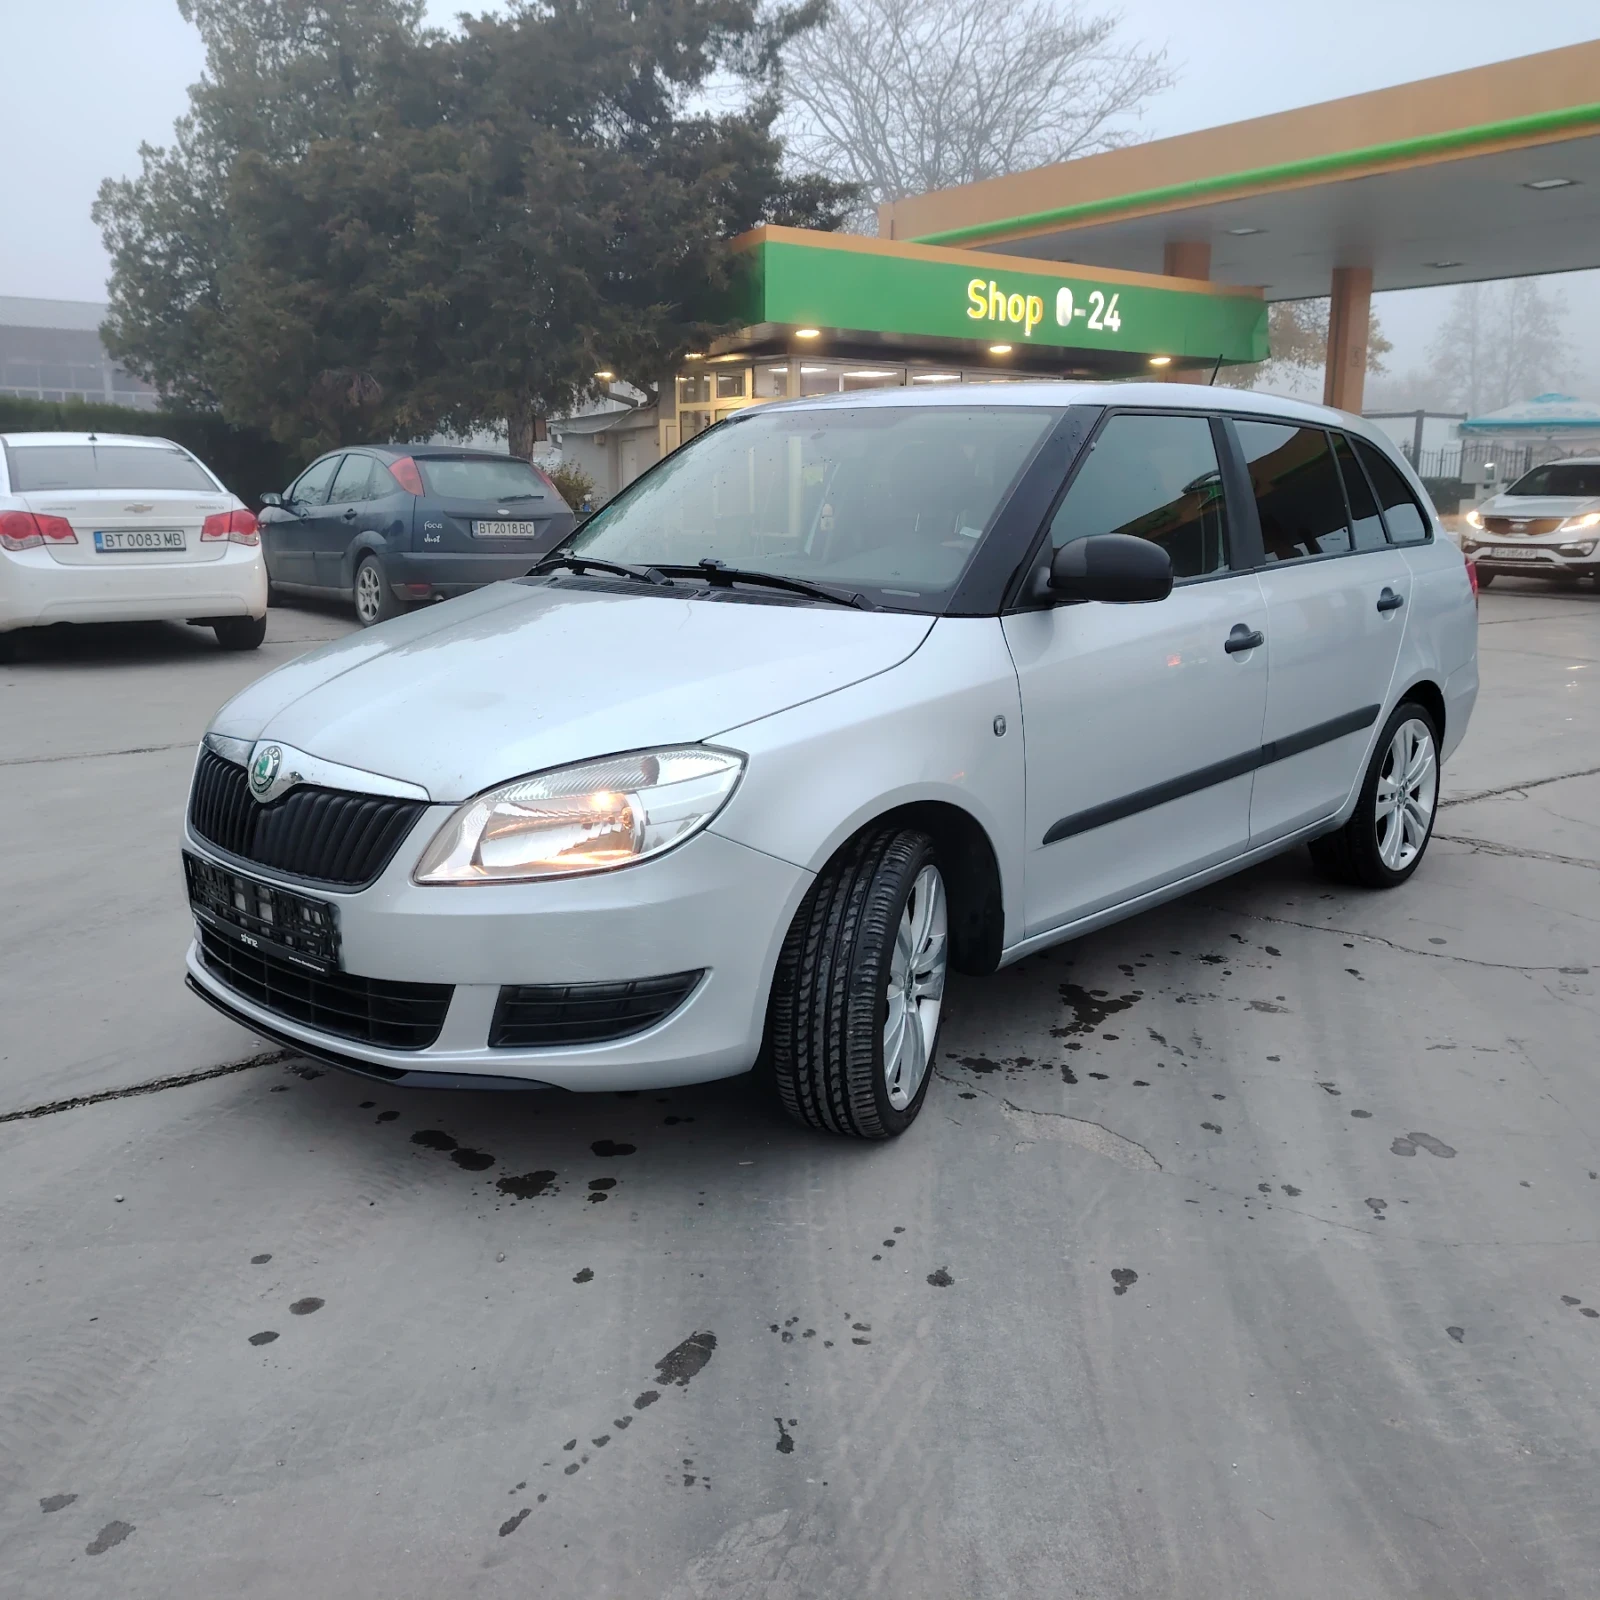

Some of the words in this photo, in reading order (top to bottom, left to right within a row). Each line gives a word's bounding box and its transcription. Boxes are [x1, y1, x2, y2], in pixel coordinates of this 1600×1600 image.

[967, 279, 1043, 336] Shop
[1056, 287, 1121, 332] 0-24
[480, 523, 492, 534] BT
[495, 523, 518, 534] 2018
[520, 523, 533, 534] BC
[105, 534, 123, 547] BT
[127, 533, 161, 547] 0083
[164, 533, 182, 546] MB
